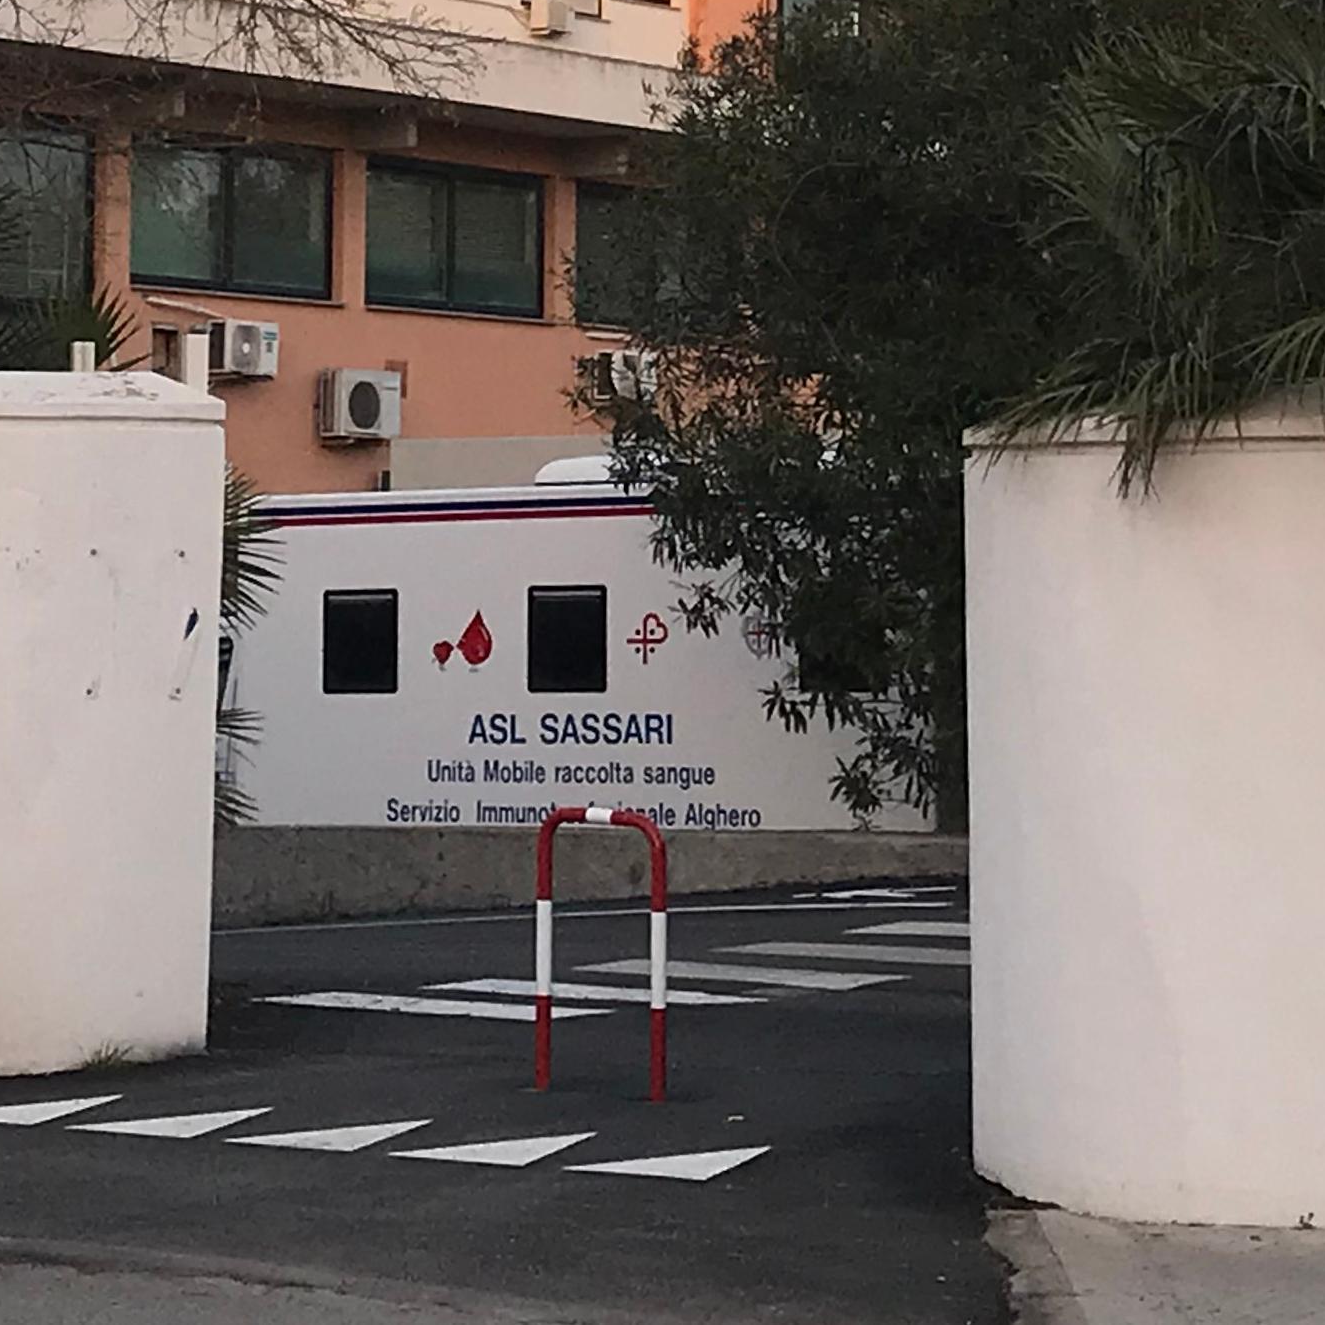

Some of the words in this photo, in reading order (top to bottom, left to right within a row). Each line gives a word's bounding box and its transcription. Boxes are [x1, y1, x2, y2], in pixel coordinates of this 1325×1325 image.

[467, 713, 527, 746] ASL
[539, 712, 674, 746] SASSARI
[427, 758, 475, 784] Unità
[483, 759, 547, 785] Mobile
[554, 761, 635, 786] raccolta
[643, 764, 716, 791] sangue
[386, 797, 461, 824] Servizio
[684, 802, 762, 831] Alghero
